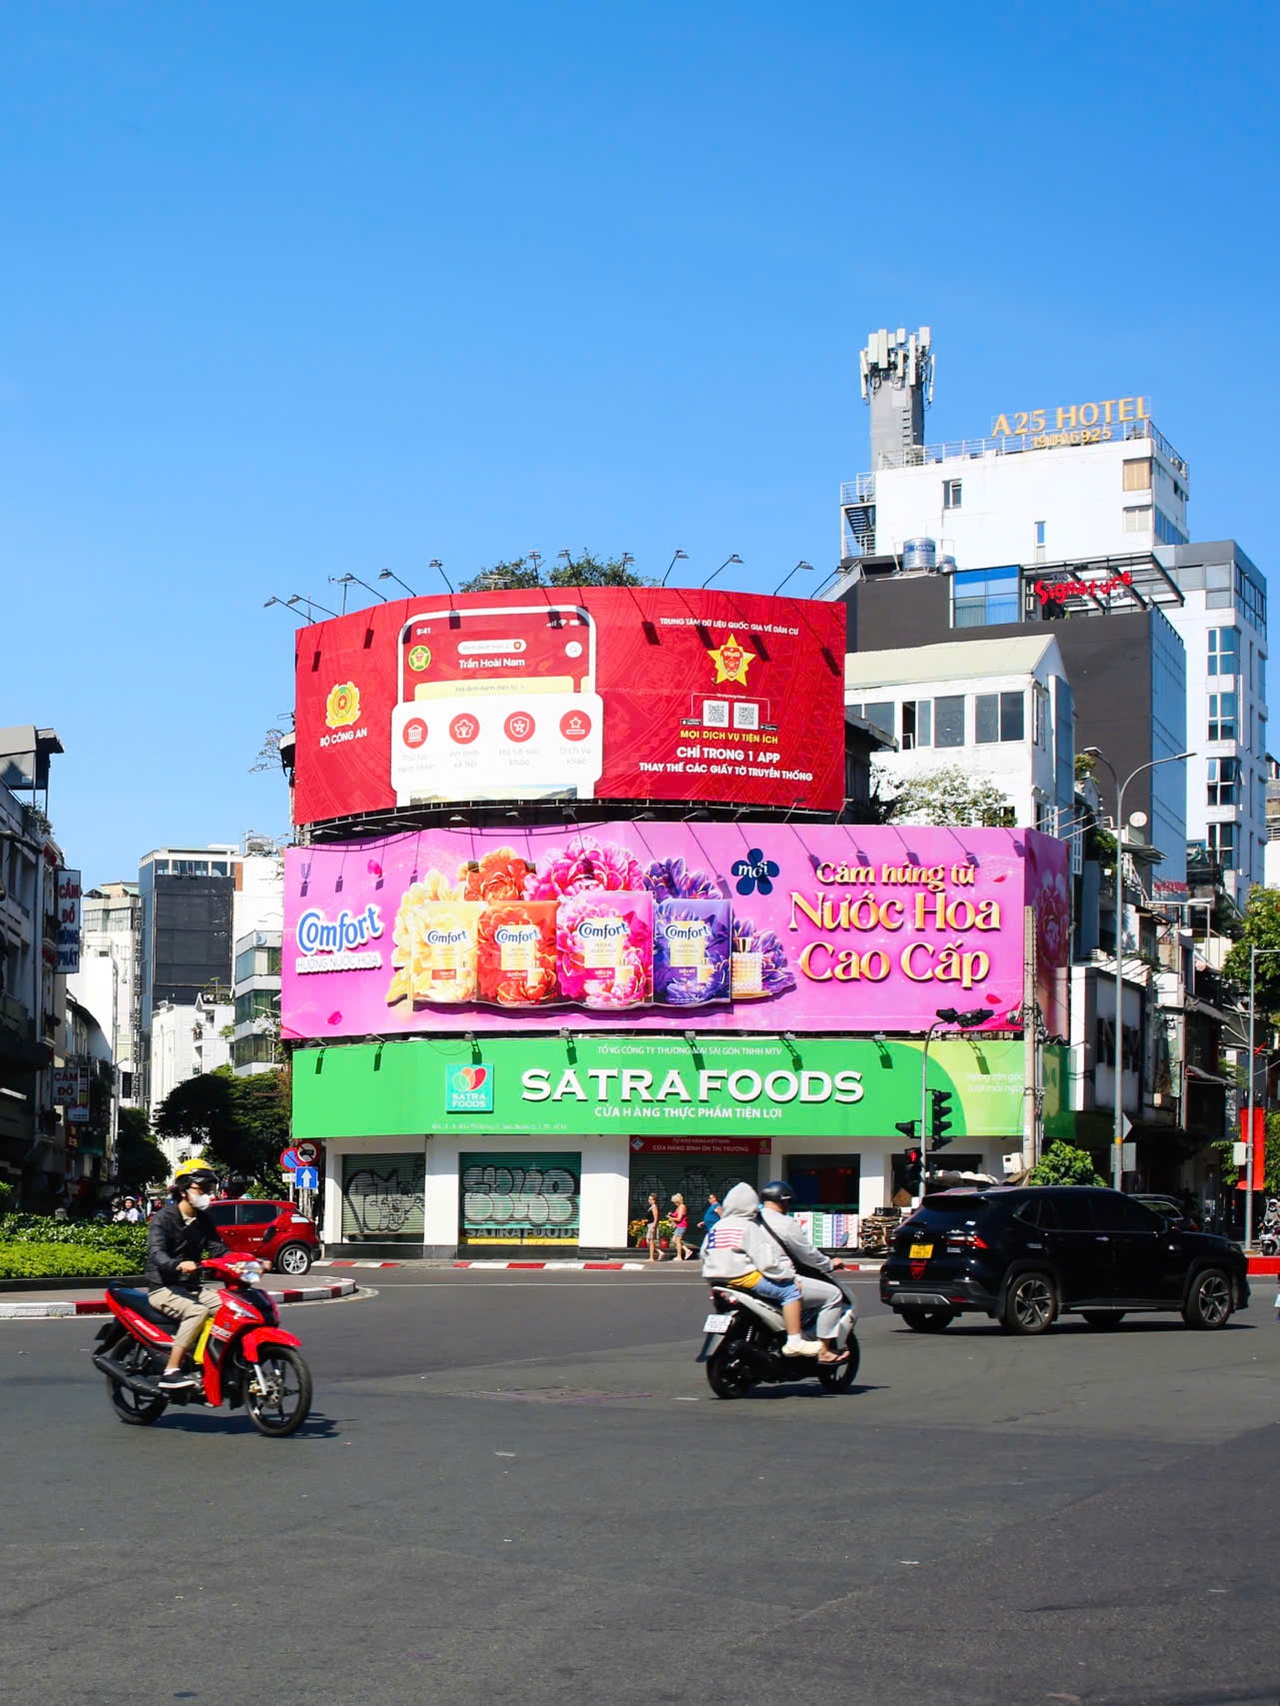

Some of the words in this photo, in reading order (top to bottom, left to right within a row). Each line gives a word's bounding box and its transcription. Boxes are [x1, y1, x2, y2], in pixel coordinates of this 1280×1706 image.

[992, 410, 1046, 437] A25
[1056, 397, 1150, 429] HOTEL
[1035, 571, 1132, 605] Signature
[417, 627, 430, 635] 9:41
[660, 618, 685, 626] TRUNG
[713, 620, 726, 628] LIỆU
[728, 620, 749, 630] QUỐC
[751, 623, 763, 631] GIA
[773, 626, 787, 634] DÂN
[459, 657, 478, 669] Trần
[480, 656, 501, 668] Hoài
[503, 657, 525, 667] Nam
[320, 735, 330, 748] BỘ
[331, 731, 355, 745] CÔNG
[356, 728, 367, 740] AN
[680, 730, 700, 739] MỌI
[702, 731, 725, 742] DỊCH
[728, 733, 740, 742] VỤ
[741, 733, 760, 744] TIỆN
[762, 734, 778, 744] ÍCH
[677, 744, 700, 758] CHỈ
[703, 748, 744, 761] TRONG
[748, 751, 753, 761] 1
[758, 752, 780, 764] APP
[639, 762, 664, 773] THAY
[666, 761, 684, 773] THẾ
[685, 762, 708, 773] CÁC
[710, 764, 733, 776] GIẤY
[734, 765, 747, 776] TỜ
[748, 767, 780, 779] TRUYỀN
[782, 768, 813, 781] THỐNG
[738, 861, 768, 878] mới
[816, 861, 875, 885] Cảm
[881, 862, 945, 892] hứng
[950, 862, 975, 885] từ
[789, 890, 904, 931] Nước
[913, 892, 1001, 931] Hoa
[298, 907, 380, 952] Comfort
[427, 929, 470, 945] Comfort
[494, 928, 540, 945] Comfort
[578, 922, 629, 939] Comfort
[665, 924, 710, 939] Comfort
[358, 954, 378, 965] HOA
[800, 942, 891, 981] Cao
[900, 939, 990, 989] Cấp
[598, 1044, 620, 1054] TỔNG
[621, 1045, 644, 1054] CÔNG
[645, 1046, 655, 1054] TY
[657, 1046, 690, 1055] THƯƠNG
[722, 1046, 740, 1055] GÒN
[741, 1047, 763, 1055] TNHH
[765, 1047, 782, 1055] MTV
[521, 1068, 692, 1102] SATRA
[698, 1068, 864, 1103] FOODS
[452, 1100, 486, 1108] FOODS
[594, 1103, 620, 1117] CỬA
[663, 1107, 696, 1120] THỰC
[698, 1104, 732, 1118] PHẨM
[734, 1105, 761, 1119] TIỆN
[763, 1107, 782, 1119] LỢI
